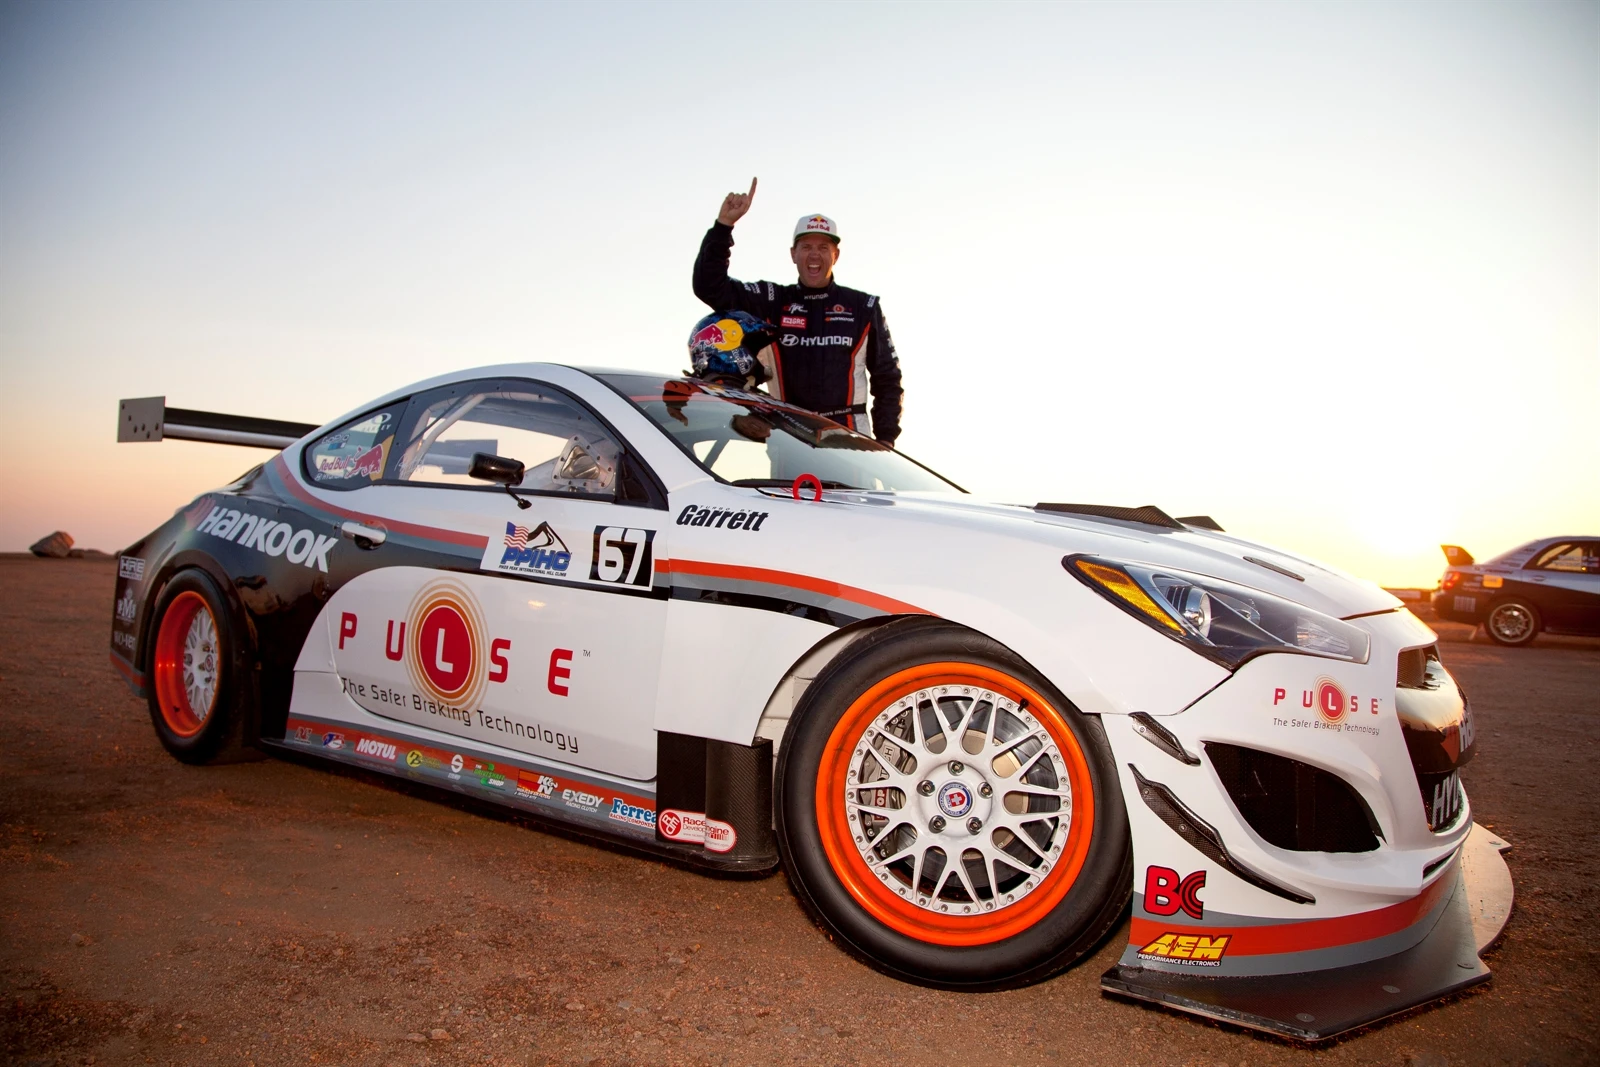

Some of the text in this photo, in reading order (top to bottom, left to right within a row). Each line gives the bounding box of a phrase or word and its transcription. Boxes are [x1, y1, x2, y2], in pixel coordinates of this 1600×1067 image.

[800, 336, 853, 346] HYUNDAI
[319, 455, 351, 472] Red Bull
[676, 504, 769, 531] Garrett
[500, 546, 571, 571] PPIHC
[598, 526, 646, 585] 67
[338, 611, 574, 697] PULSE
[1274, 688, 1379, 715] PULSE
[341, 677, 579, 754] The Safer Braking Technology
[1273, 718, 1380, 736] The Safer Braking Technology
[356, 738, 397, 760] MOTUL
[488, 778, 504, 787] SHOP
[562, 788, 604, 808] EXEDY
[566, 801, 598, 813] RACING CLUTCH
[609, 813, 627, 821] RACING
[1143, 865, 1207, 920] BC
[1139, 932, 1230, 960] AEM
[1137, 953, 1221, 967] PERFORMANCE ELECTRONICS
